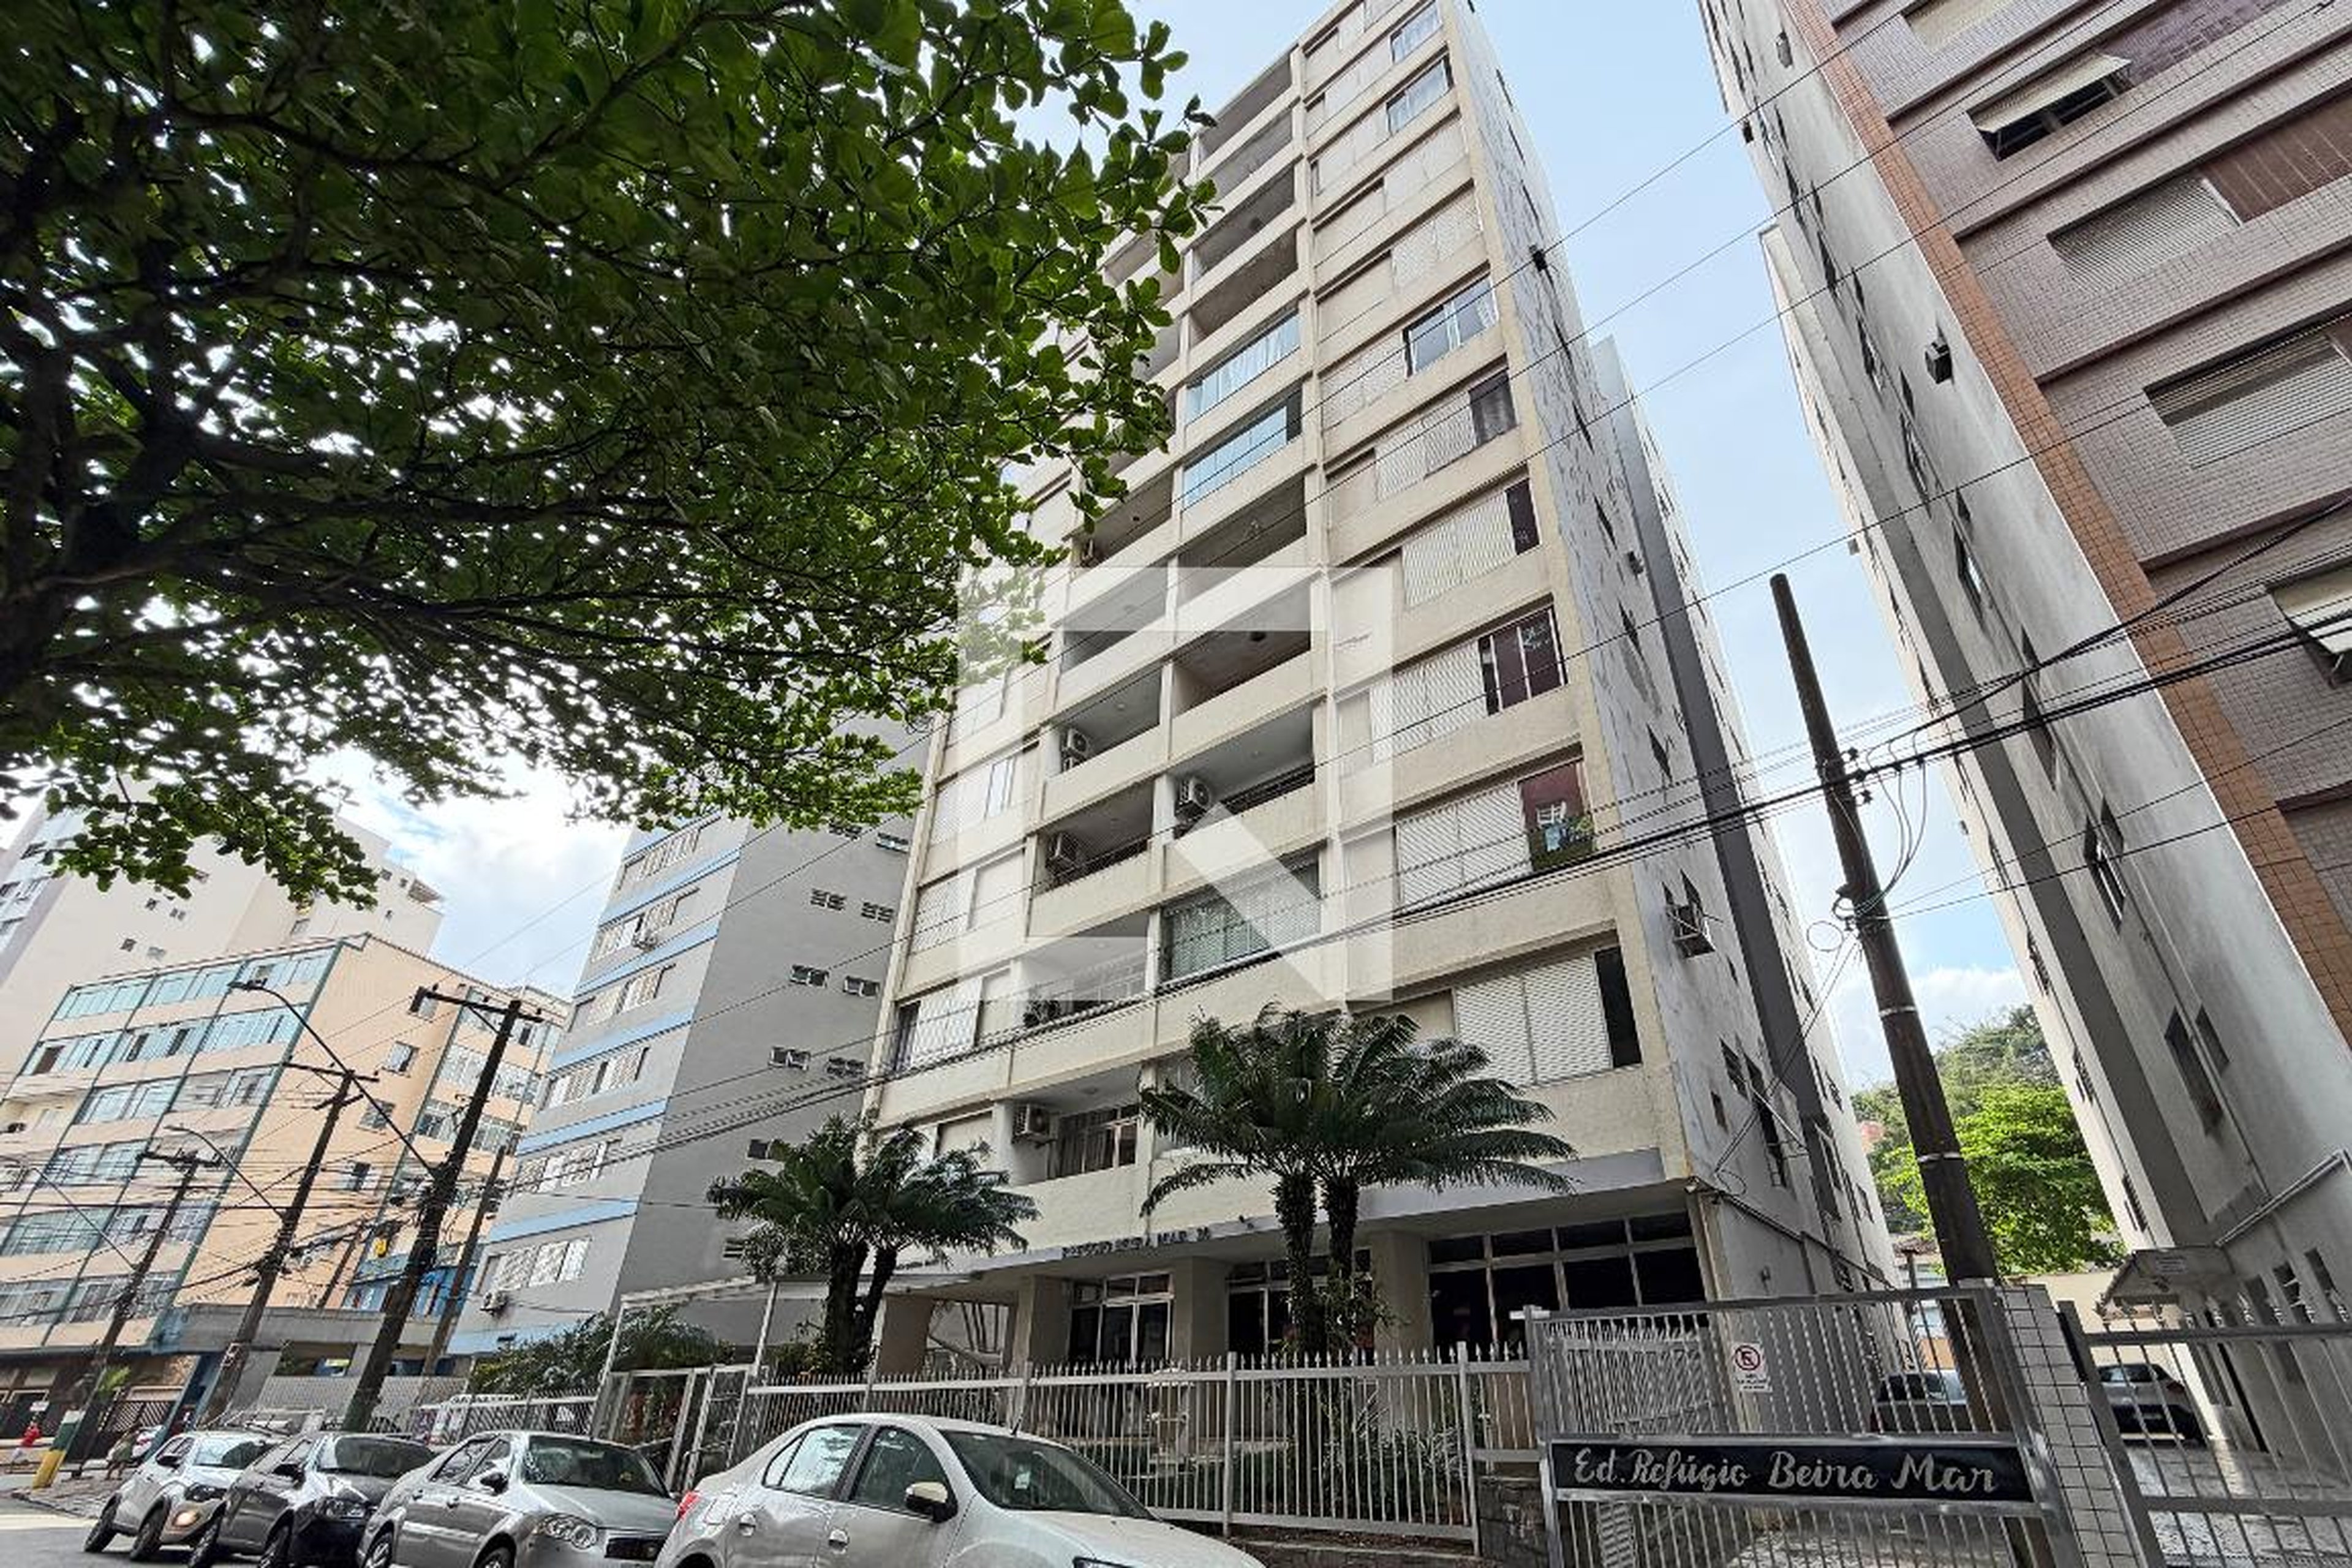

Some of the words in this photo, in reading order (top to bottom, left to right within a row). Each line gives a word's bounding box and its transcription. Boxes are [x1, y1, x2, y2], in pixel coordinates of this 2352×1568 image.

[1574, 1447, 1626, 1483] Ed.
[1627, 1449, 1751, 1491] Refúgio
[1768, 1450, 1879, 1489] Beira
[1891, 1453, 1997, 1493] Mar
